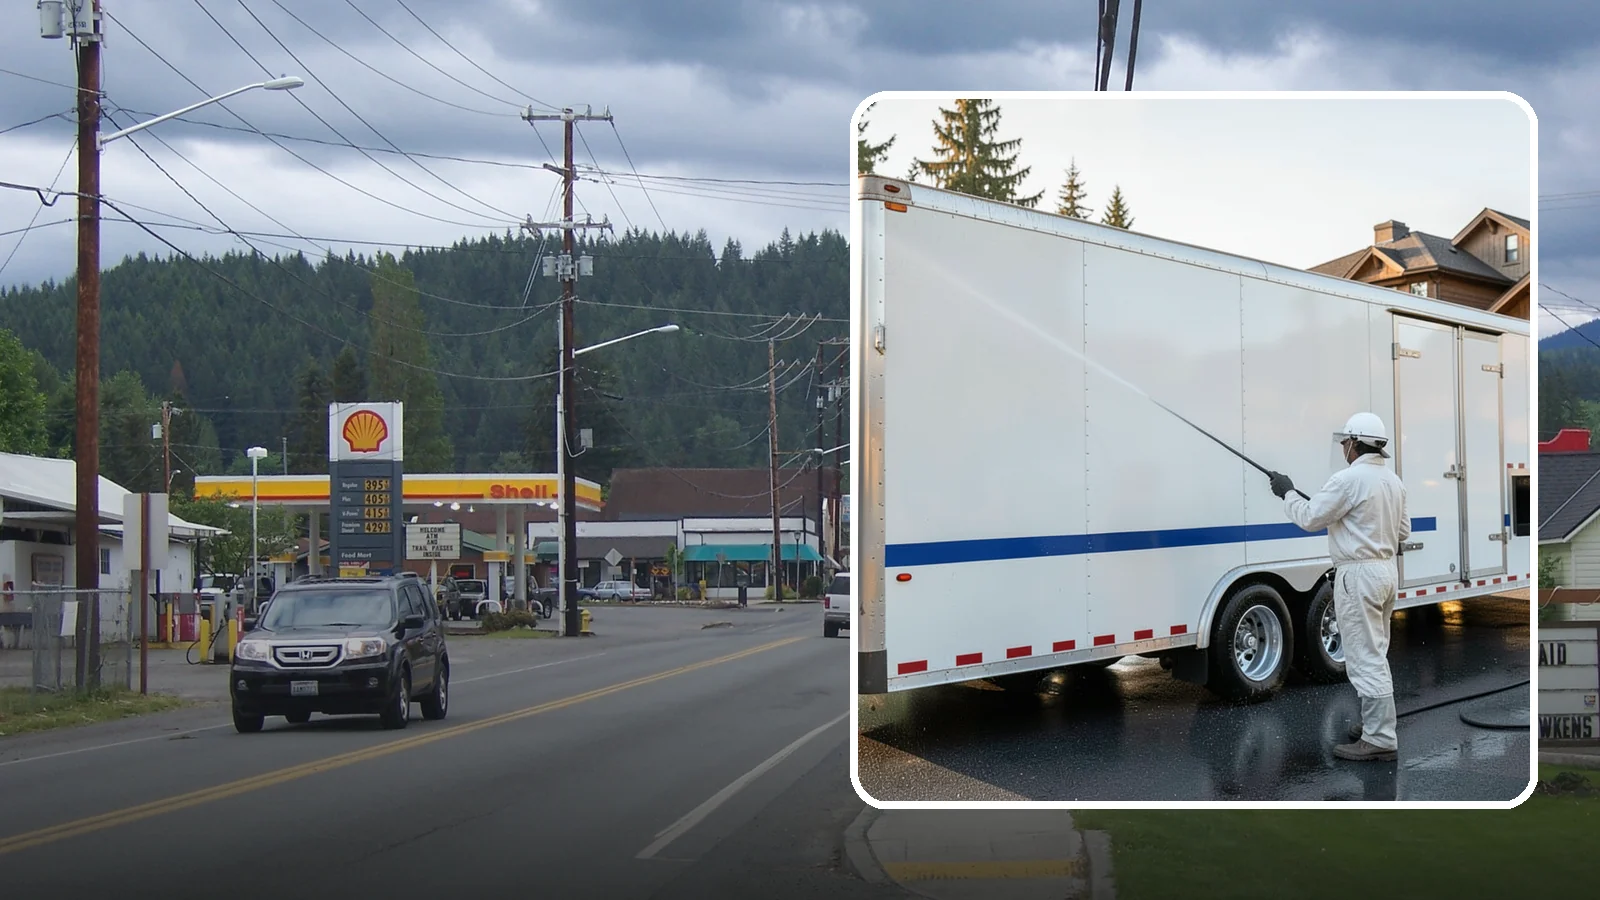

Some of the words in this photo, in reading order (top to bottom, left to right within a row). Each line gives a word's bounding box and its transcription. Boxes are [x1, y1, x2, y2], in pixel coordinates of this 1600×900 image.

[366, 480, 383, 490] 395
[490, 484, 547, 499] Shell
[366, 494, 383, 504] 405
[366, 508, 383, 518] 415
[366, 522, 383, 532] 429
